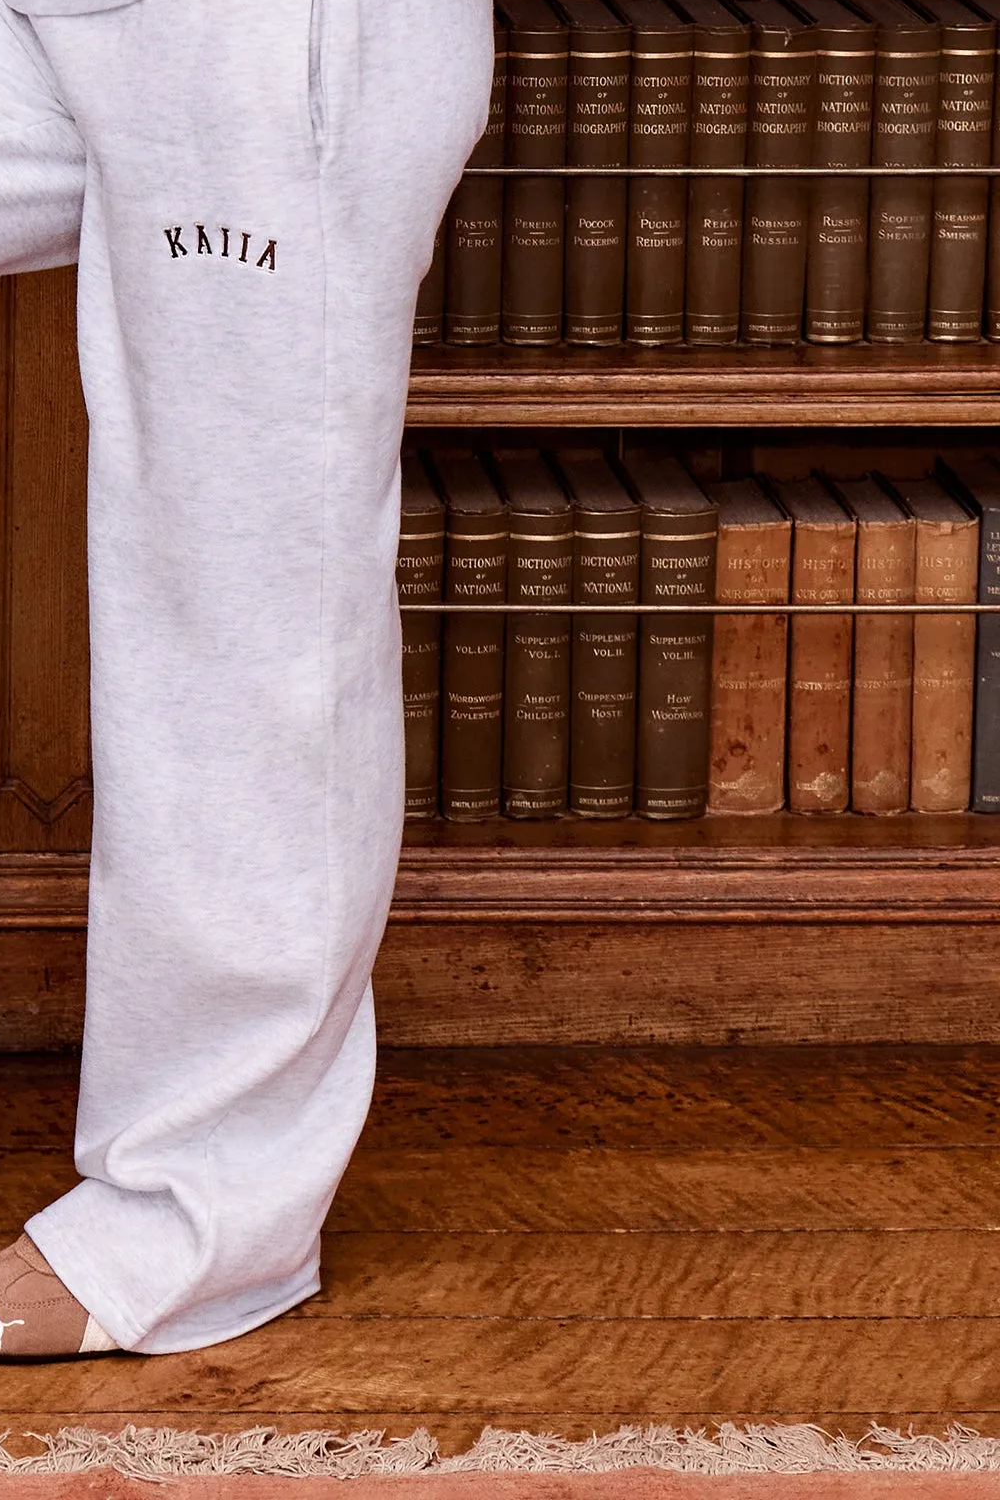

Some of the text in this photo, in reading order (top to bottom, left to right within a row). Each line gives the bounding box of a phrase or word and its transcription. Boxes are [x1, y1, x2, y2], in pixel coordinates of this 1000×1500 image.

[513, 76, 567, 87] DICTIONARY
[574, 75, 628, 87] DICTIONARY
[634, 76, 689, 87] DICTIONARY
[754, 75, 811, 86] DICTIONARY
[819, 74, 873, 86] DICTIONARY
[516, 104, 564, 115] NATIONAL
[577, 103, 625, 115] NATIONAL
[637, 103, 686, 115] NATIONAL
[756, 103, 806, 115] NATIONAL
[822, 102, 869, 112] NATIONAL
[882, 103, 930, 114] NATIONAL
[942, 100, 989, 111] NATIONAL
[512, 123, 566, 134] BIOGRAPHY
[573, 122, 626, 134] BIOGRAPHY
[634, 122, 687, 134] BIOGRAPHY
[753, 122, 807, 134] BIOGRAPHY
[579, 219, 614, 228] POCOCK
[458, 237, 494, 247] PERCY
[752, 234, 798, 244] RUSSELL
[164, 225, 277, 270] KAIIA
[451, 555, 505, 568] DICTIONARY
[517, 556, 572, 569] DICTIONARY
[581, 554, 637, 567] DICTIONARY
[651, 555, 709, 568] DICTIONARY
[454, 583, 502, 595] NATIONAL
[520, 584, 567, 596] NATIONAL
[584, 582, 633, 593] NATIONAL
[655, 583, 705, 595] NATIONAL
[650, 635, 707, 644] SUPPLEMENT
[667, 695, 691, 704] HOW
